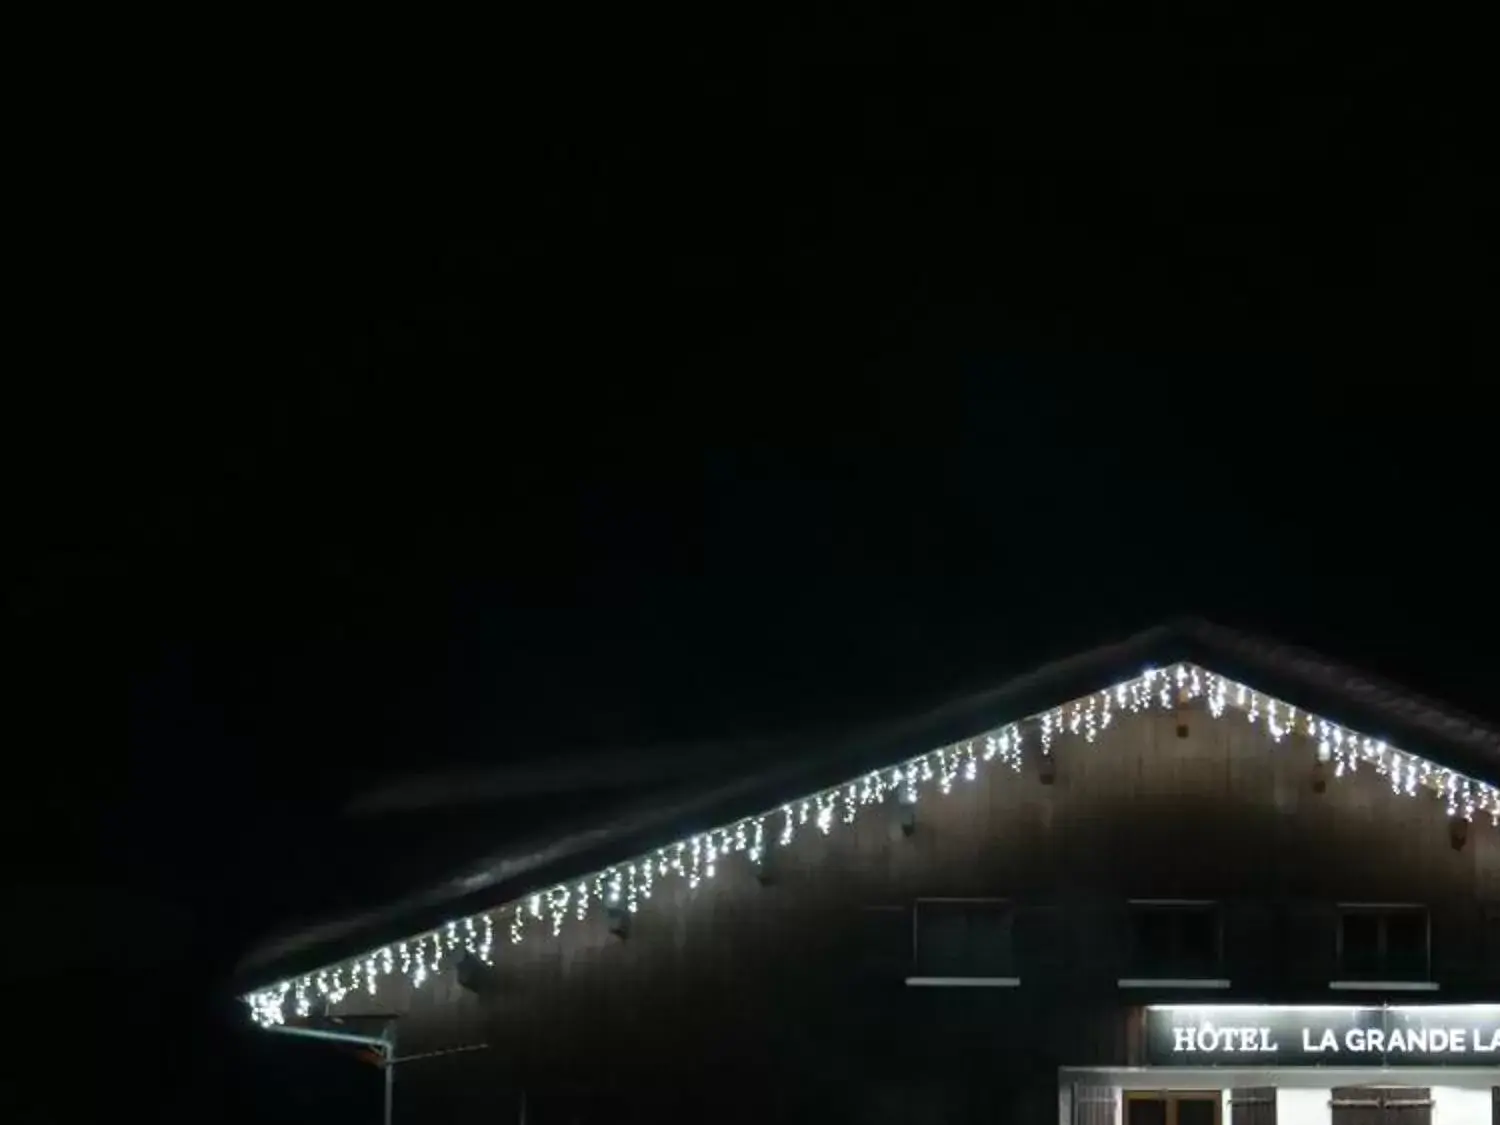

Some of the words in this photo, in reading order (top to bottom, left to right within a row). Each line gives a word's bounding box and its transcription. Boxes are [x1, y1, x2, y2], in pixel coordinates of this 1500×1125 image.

[1173, 1022, 1278, 1053] HÔTEL
[1302, 1030, 1339, 1053] LA
[1345, 1029, 1466, 1053] GRANDE
